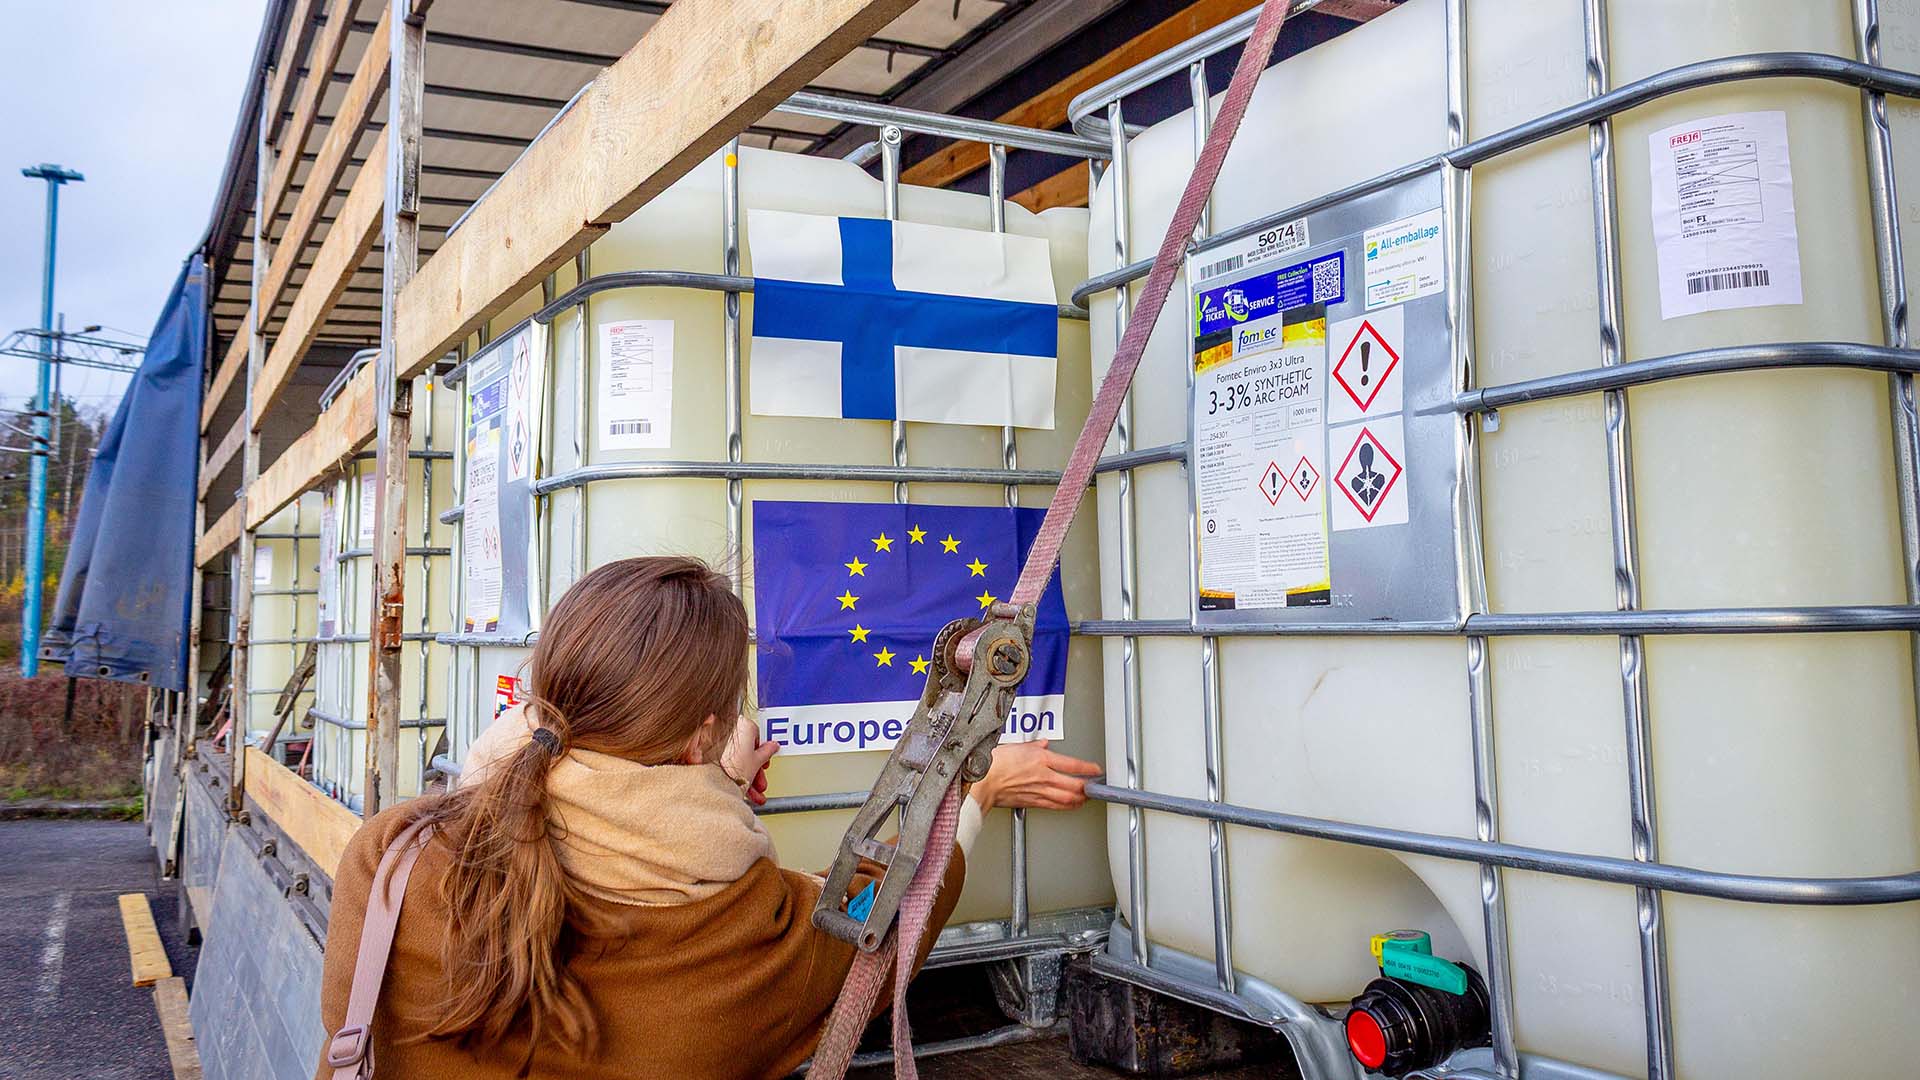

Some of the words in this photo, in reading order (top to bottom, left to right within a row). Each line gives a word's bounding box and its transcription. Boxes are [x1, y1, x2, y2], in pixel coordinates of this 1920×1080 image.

[1671, 132, 1699, 146] FREJA
[1696, 214, 1708, 224] FI
[1258, 224, 1295, 247] 5074
[1380, 225, 1439, 251] All-emballage
[1205, 309, 1226, 322] TICKET
[1249, 296, 1275, 311] SERVICE
[1238, 327, 1277, 353] fomtec
[1216, 370, 1242, 384] Fomtec
[1244, 364, 1267, 377] Enviro
[1269, 358, 1283, 371] 3x3
[1284, 354, 1305, 367] Ultra
[1254, 367, 1313, 392] SYNTHETIC
[1209, 382, 1251, 415] 3-3%
[1254, 390, 1276, 406] ARC
[1278, 382, 1310, 401] FOAM
[766, 717, 911, 749] Europe
